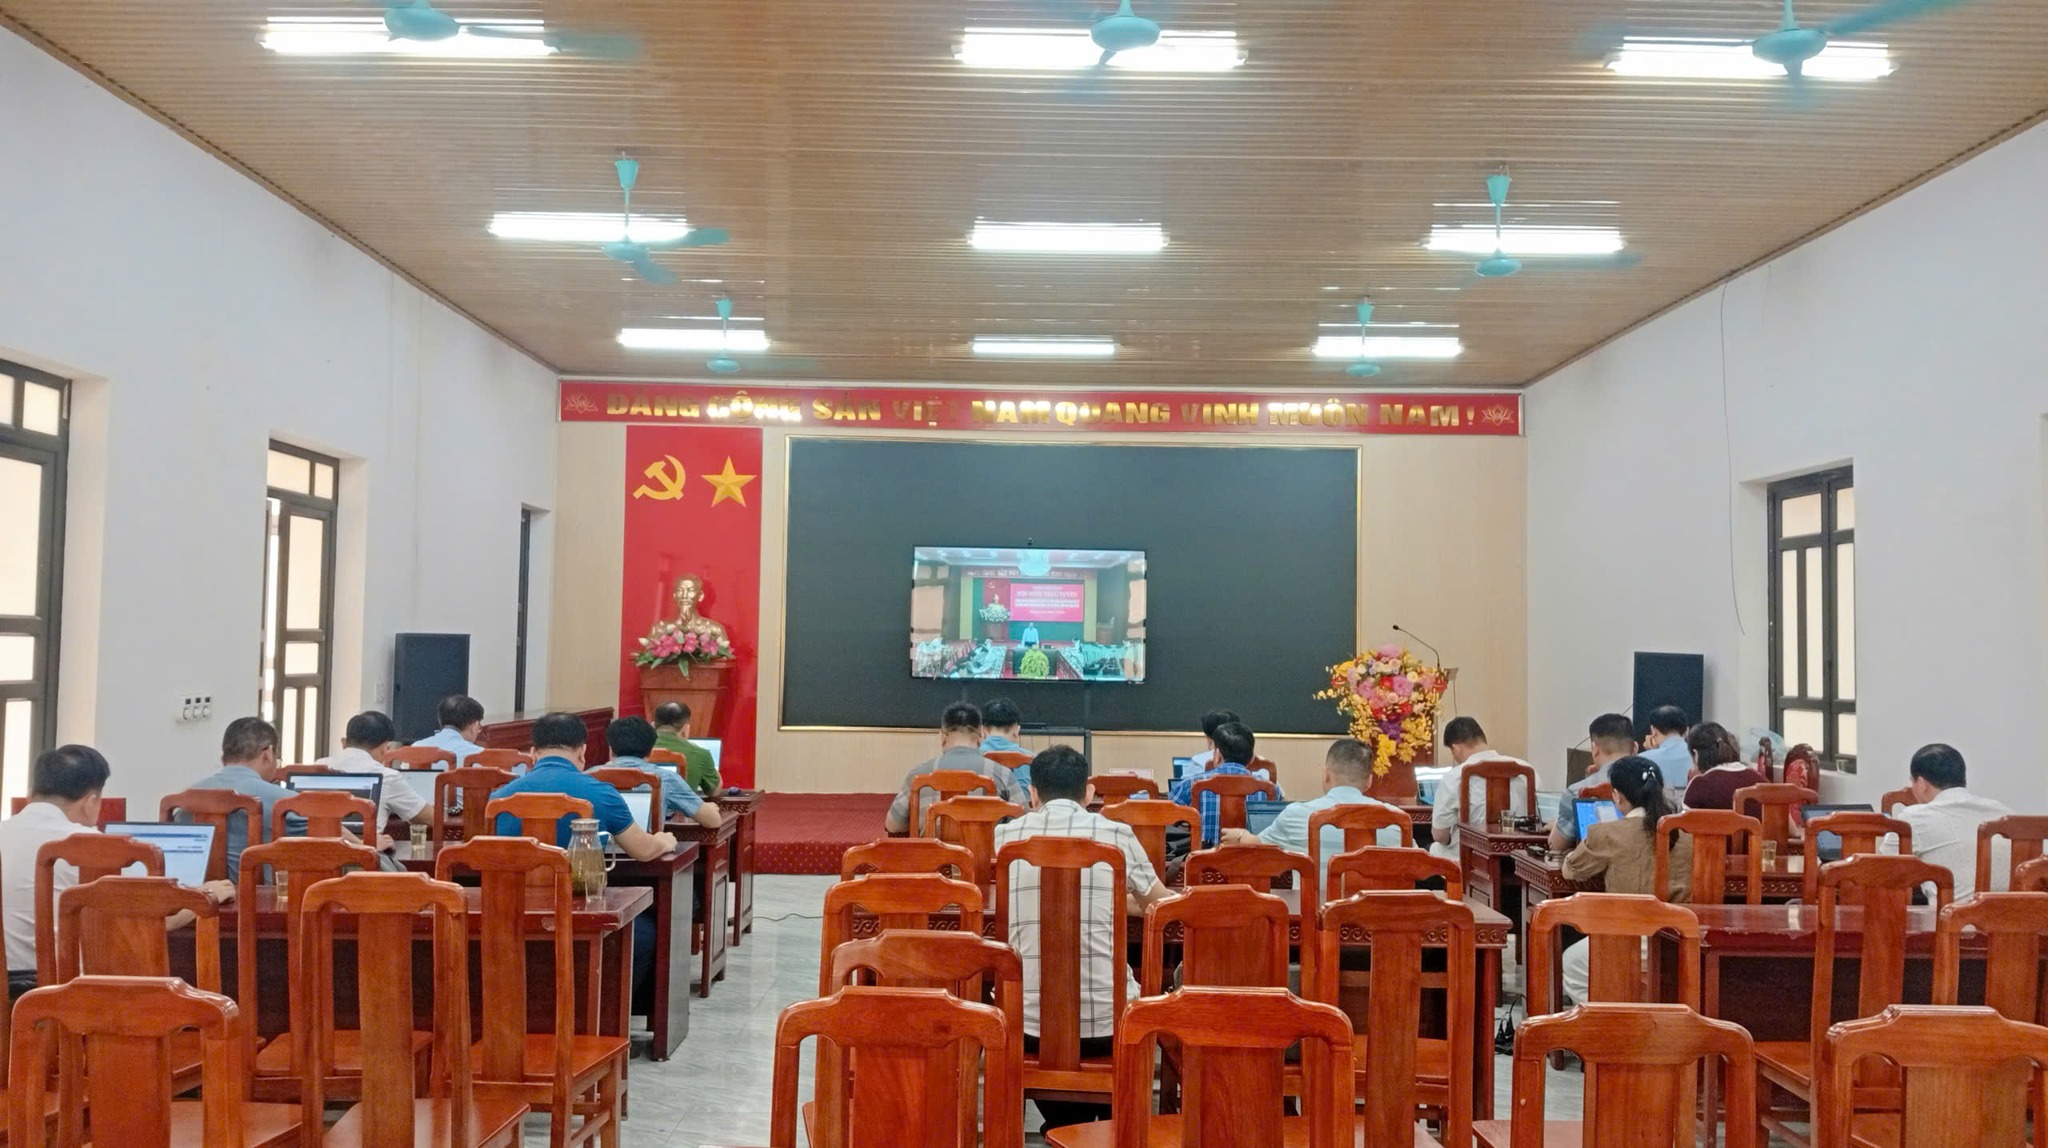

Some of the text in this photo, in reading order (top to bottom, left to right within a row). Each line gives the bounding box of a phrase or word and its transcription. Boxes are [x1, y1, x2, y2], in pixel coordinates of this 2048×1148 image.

[971, 400, 1051, 424] NAM
[1055, 401, 1170, 426] QUANG
[1180, 402, 1260, 425] VINH
[1267, 398, 1369, 426] MUÔN
